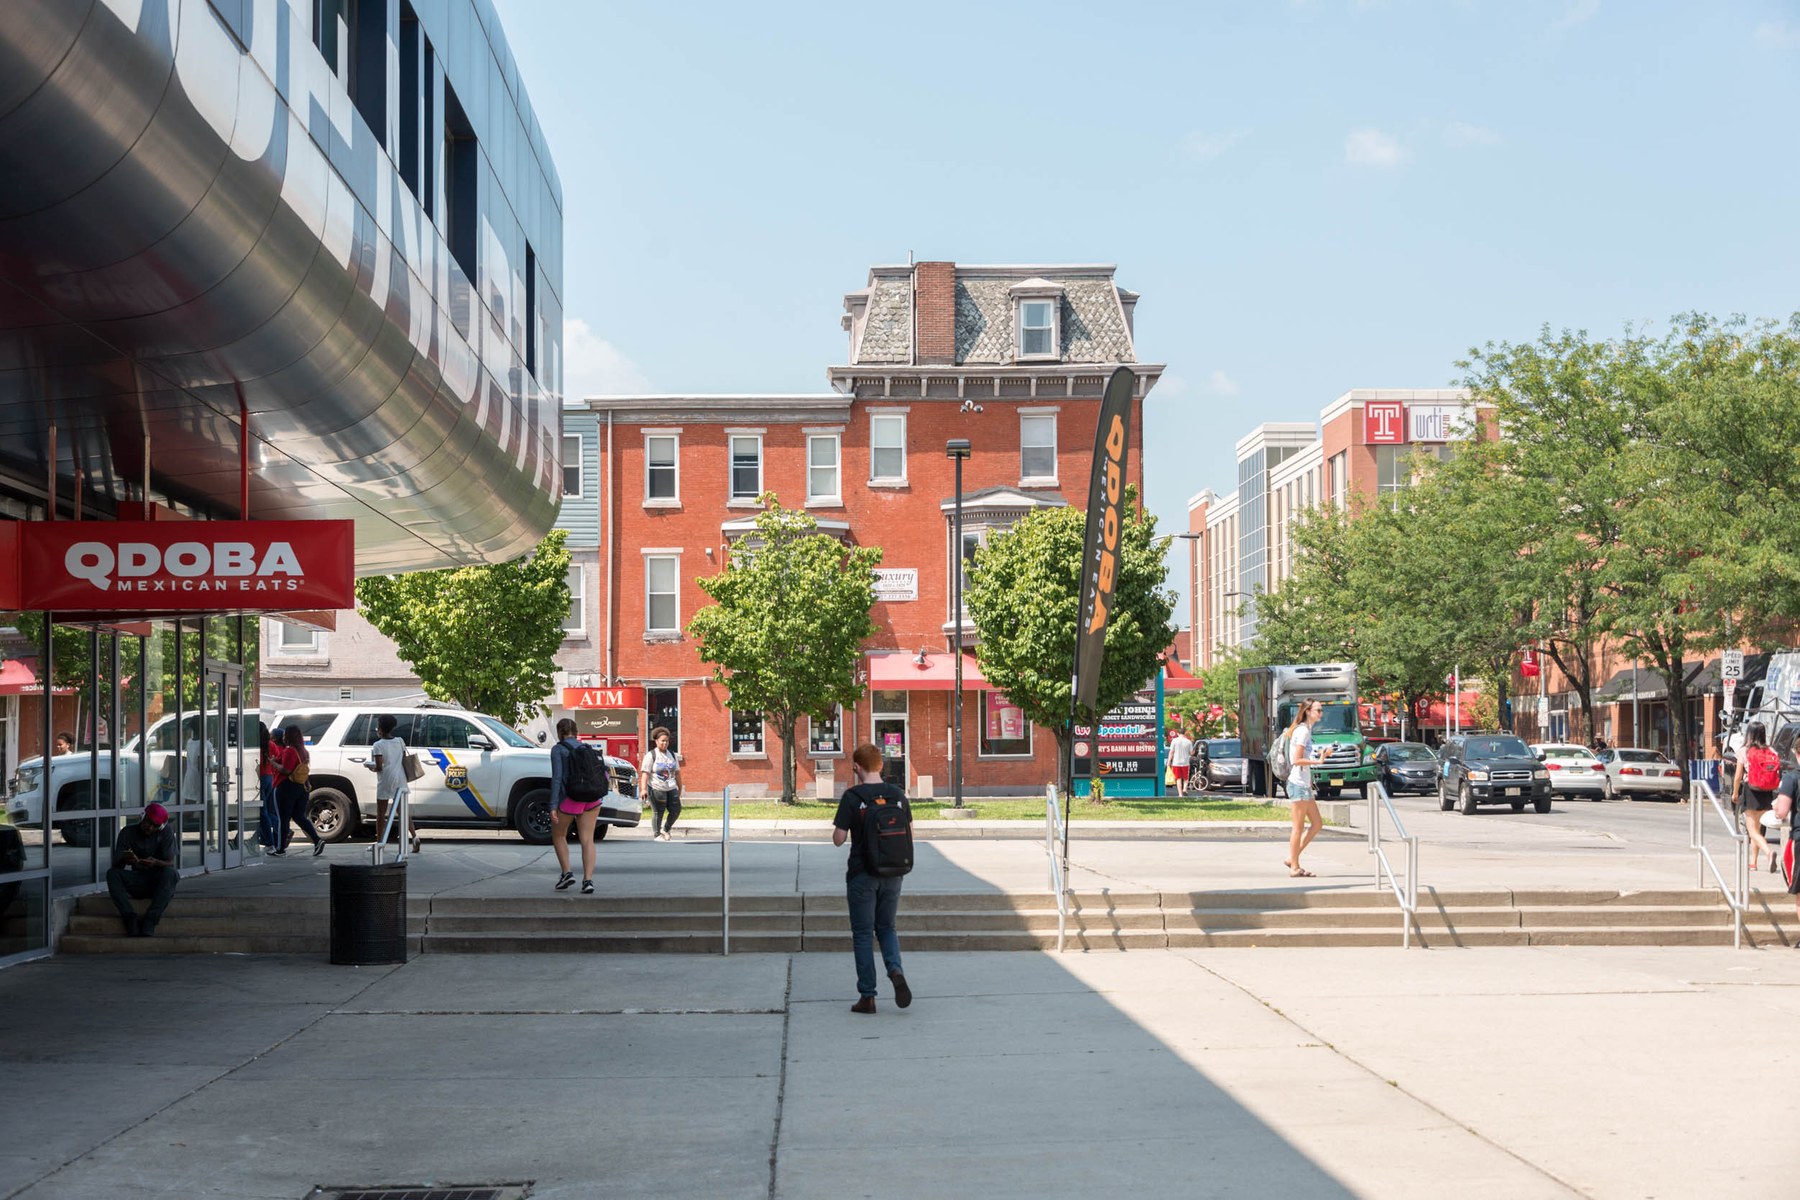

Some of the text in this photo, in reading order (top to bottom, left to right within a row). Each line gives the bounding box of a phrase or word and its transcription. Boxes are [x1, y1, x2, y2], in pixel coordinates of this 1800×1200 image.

[1095, 455, 1108, 561] MEXICAN
[1088, 414, 1125, 636] QDOBA
[64, 541, 304, 591] QDOBA
[117, 579, 227, 591] MEXICAN
[1725, 665, 1740, 676] 25
[579, 690, 624, 706] ATM
